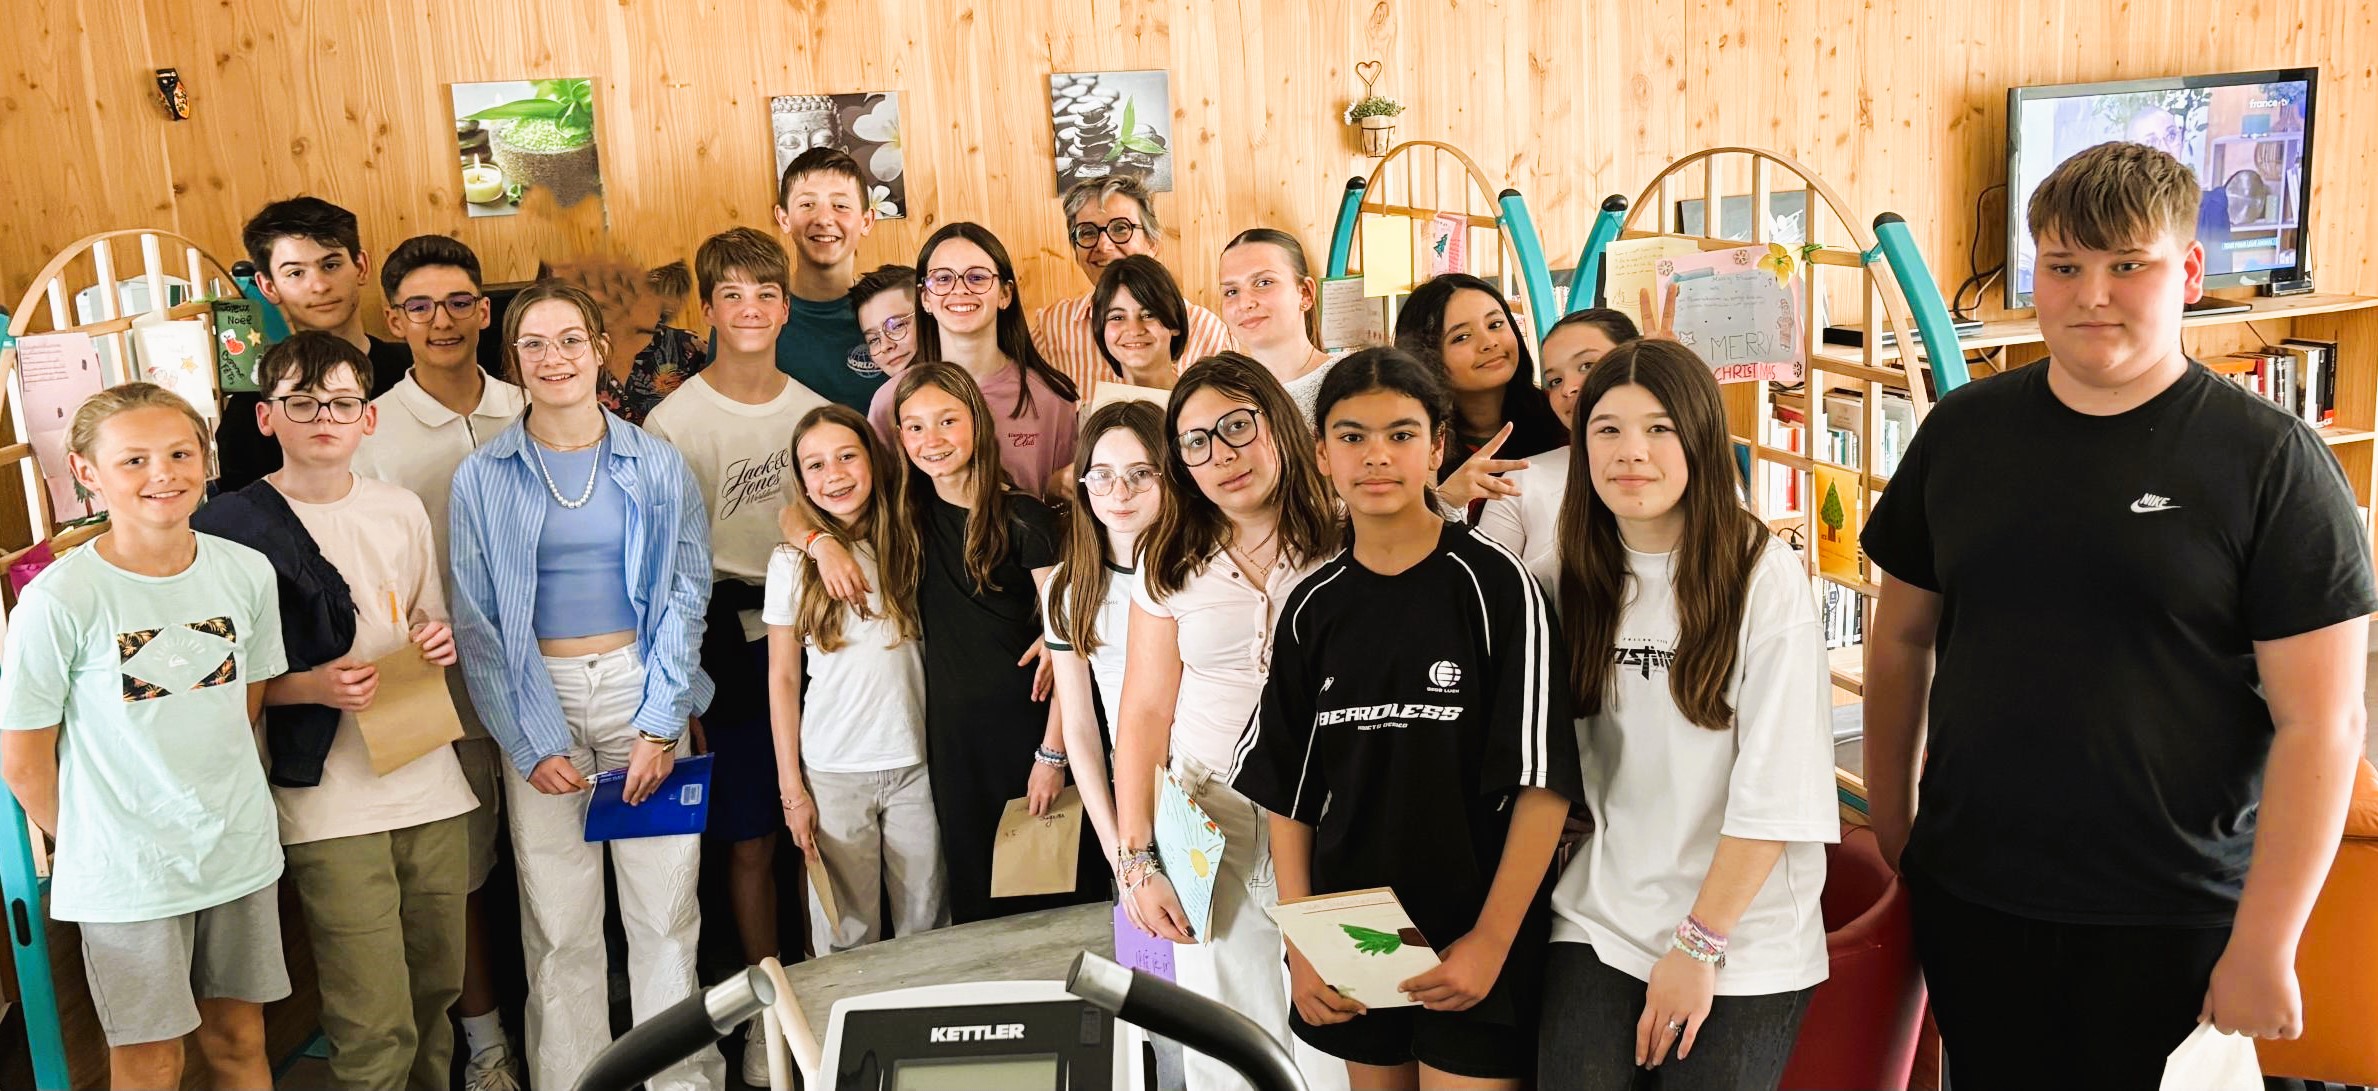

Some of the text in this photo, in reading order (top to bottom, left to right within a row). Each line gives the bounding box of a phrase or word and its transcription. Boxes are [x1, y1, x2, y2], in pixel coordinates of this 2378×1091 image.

[1710, 331, 1775, 361] MERRY
[1713, 362, 1777, 381] CHRISTMAS
[722, 452, 775, 498] Jack
[720, 470, 782, 520] Jones
[2140, 493, 2171, 507] NIKE
[1319, 703, 1464, 726] BEARDLESS
[930, 1023, 1025, 1043] KETTLER
